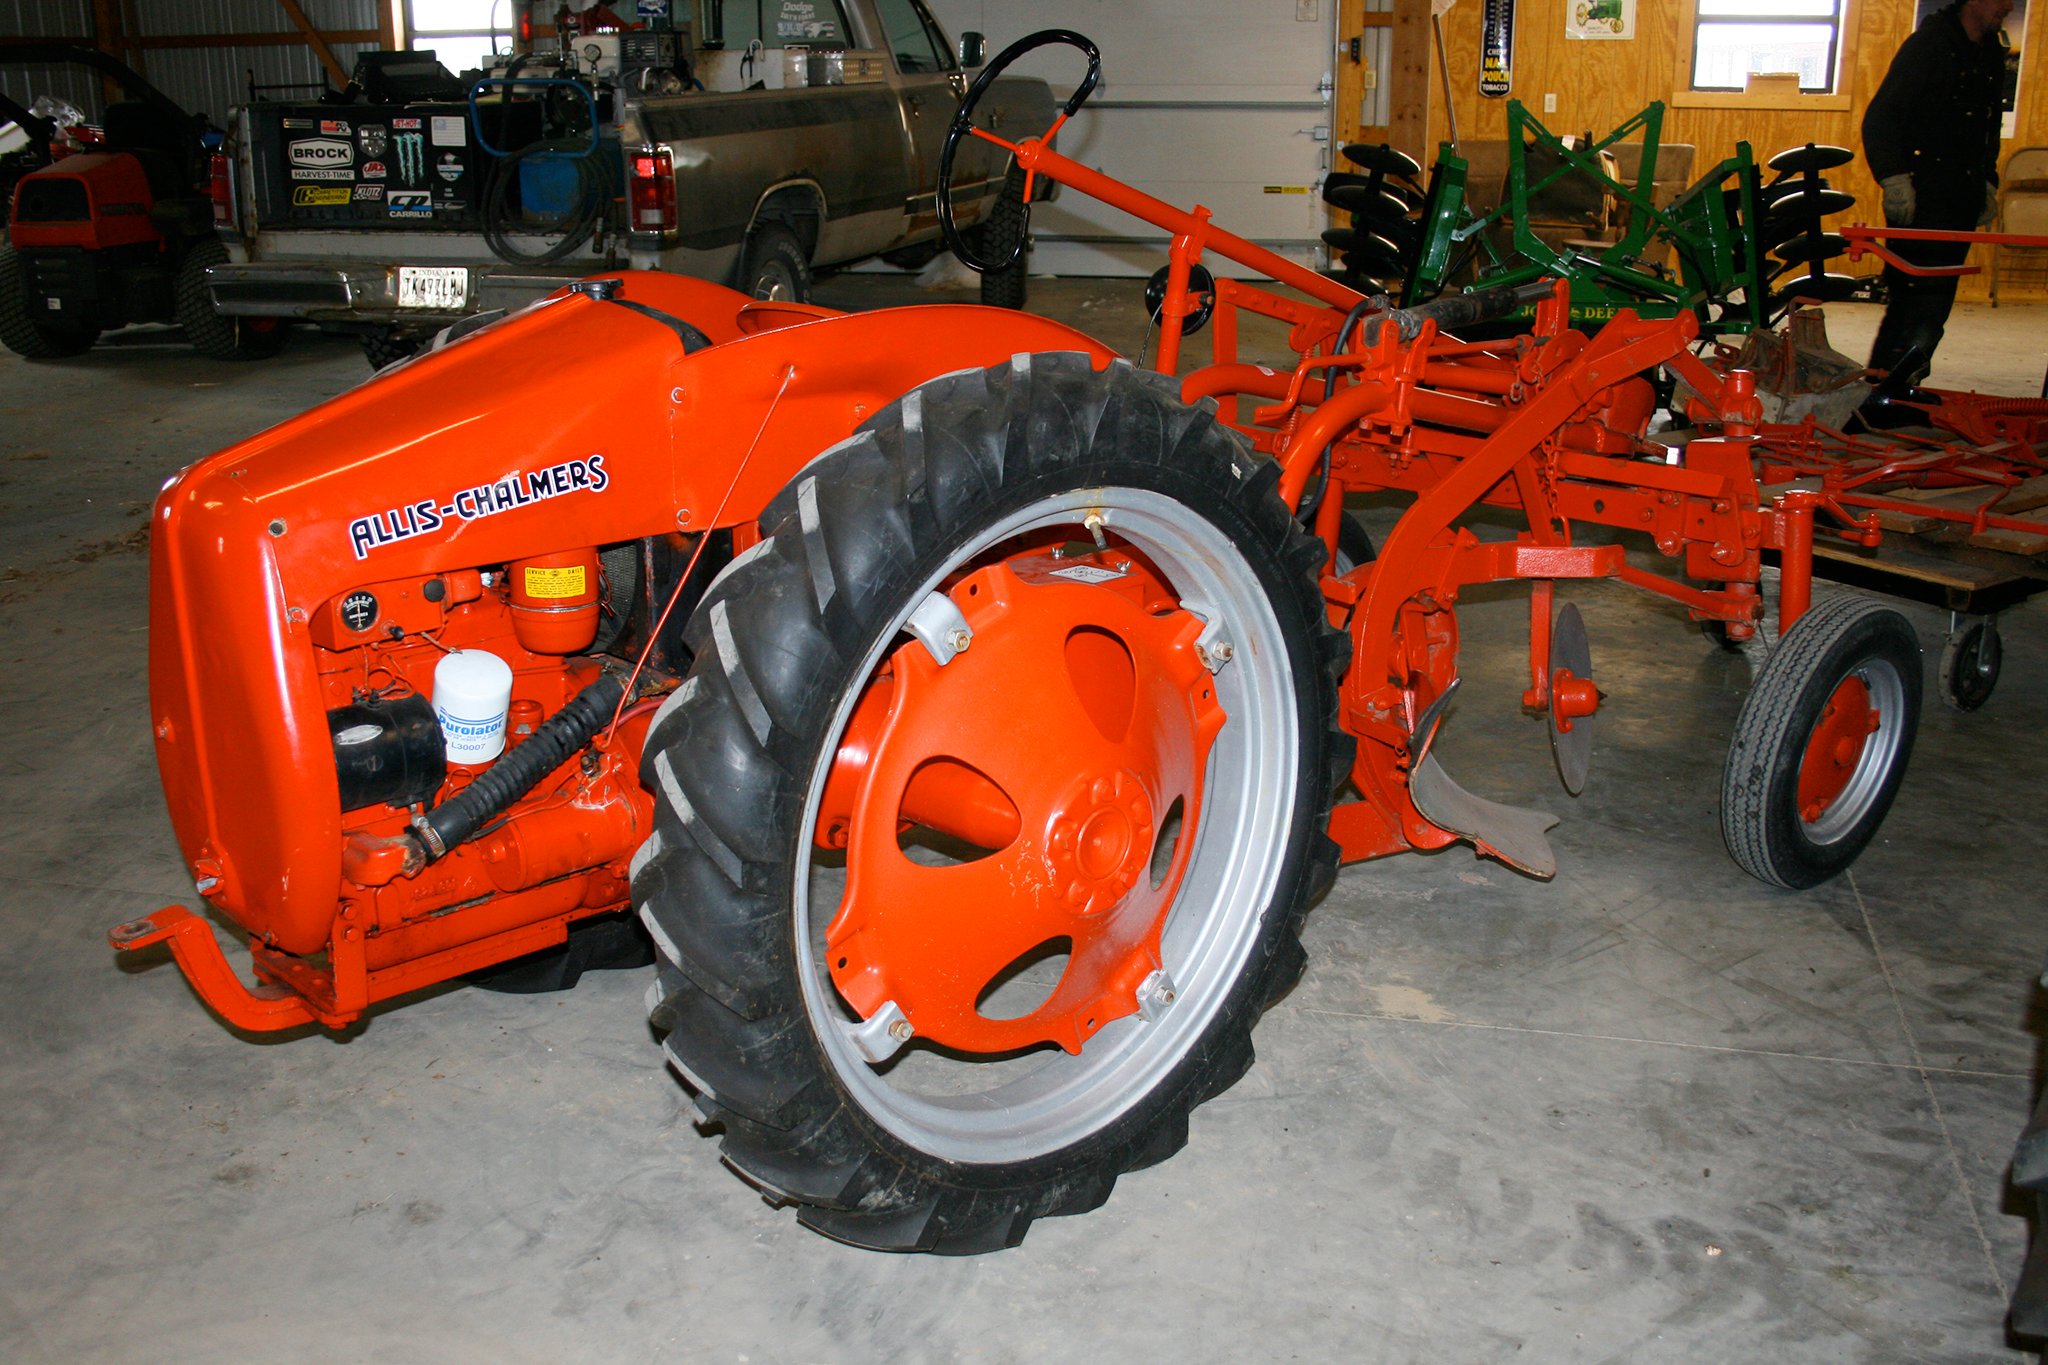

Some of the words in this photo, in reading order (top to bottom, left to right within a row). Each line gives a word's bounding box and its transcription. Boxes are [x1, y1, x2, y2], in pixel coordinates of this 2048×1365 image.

[782, 2, 814, 15] Dodge
[1482, 71, 1510, 82] POUCH
[1482, 83, 1508, 92] TOBACCO
[293, 148, 348, 159] BROCK
[294, 169, 352, 179] HARVEST-TIME
[358, 187, 381, 198] KLOTZ
[1584, 306, 1617, 320] DEE
[349, 454, 609, 560] ALLIS-CHALMERS
[438, 713, 504, 736] Purolator
[451, 741, 487, 752] L30007
